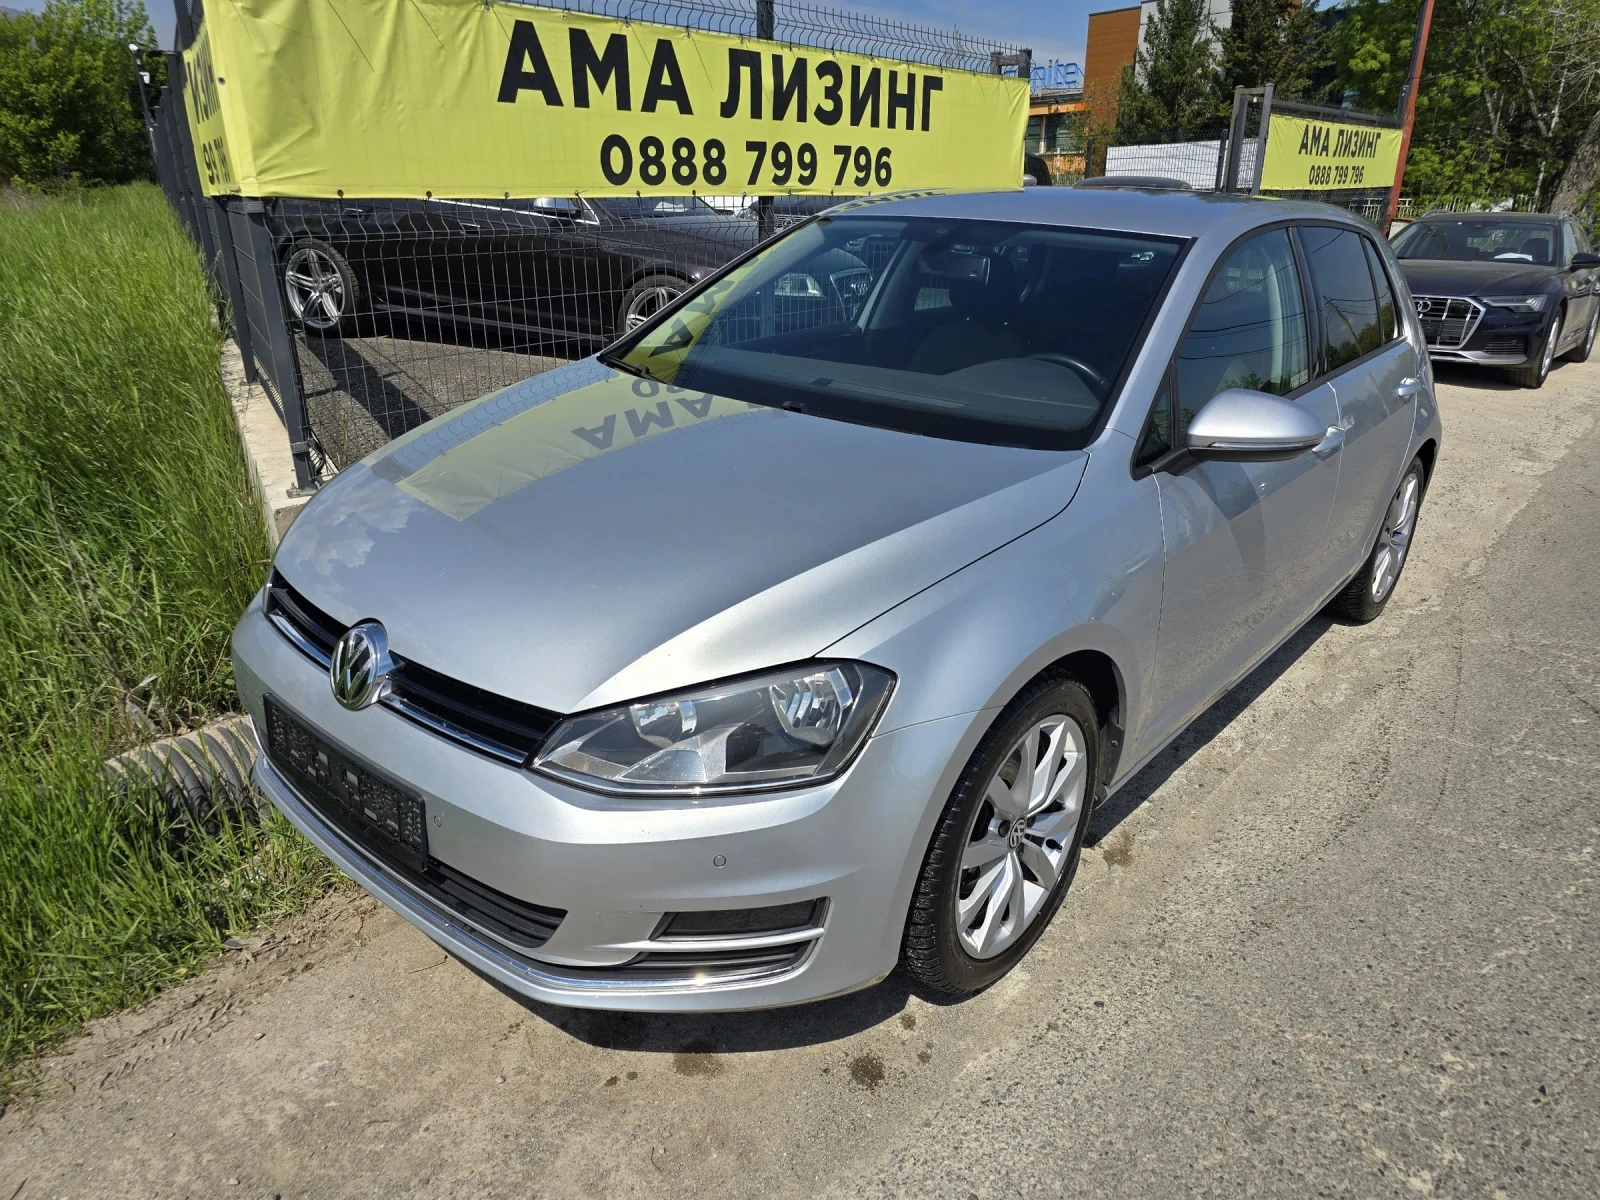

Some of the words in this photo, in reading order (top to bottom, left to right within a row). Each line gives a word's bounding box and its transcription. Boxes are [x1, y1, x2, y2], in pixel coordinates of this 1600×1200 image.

[496, 19, 694, 116] АМА
[719, 47, 944, 132] ЛИЗИНГ
[600, 133, 727, 186] 0888
[745, 140, 818, 186] 799
[833, 144, 892, 188] 796
[1298, 124, 1330, 157] АМА
[1332, 128, 1382, 159] ЛИЗИНГ
[1308, 164, 1331, 186] 0888
[1332, 165, 1349, 185] 799
[1349, 165, 1365, 185] 796
